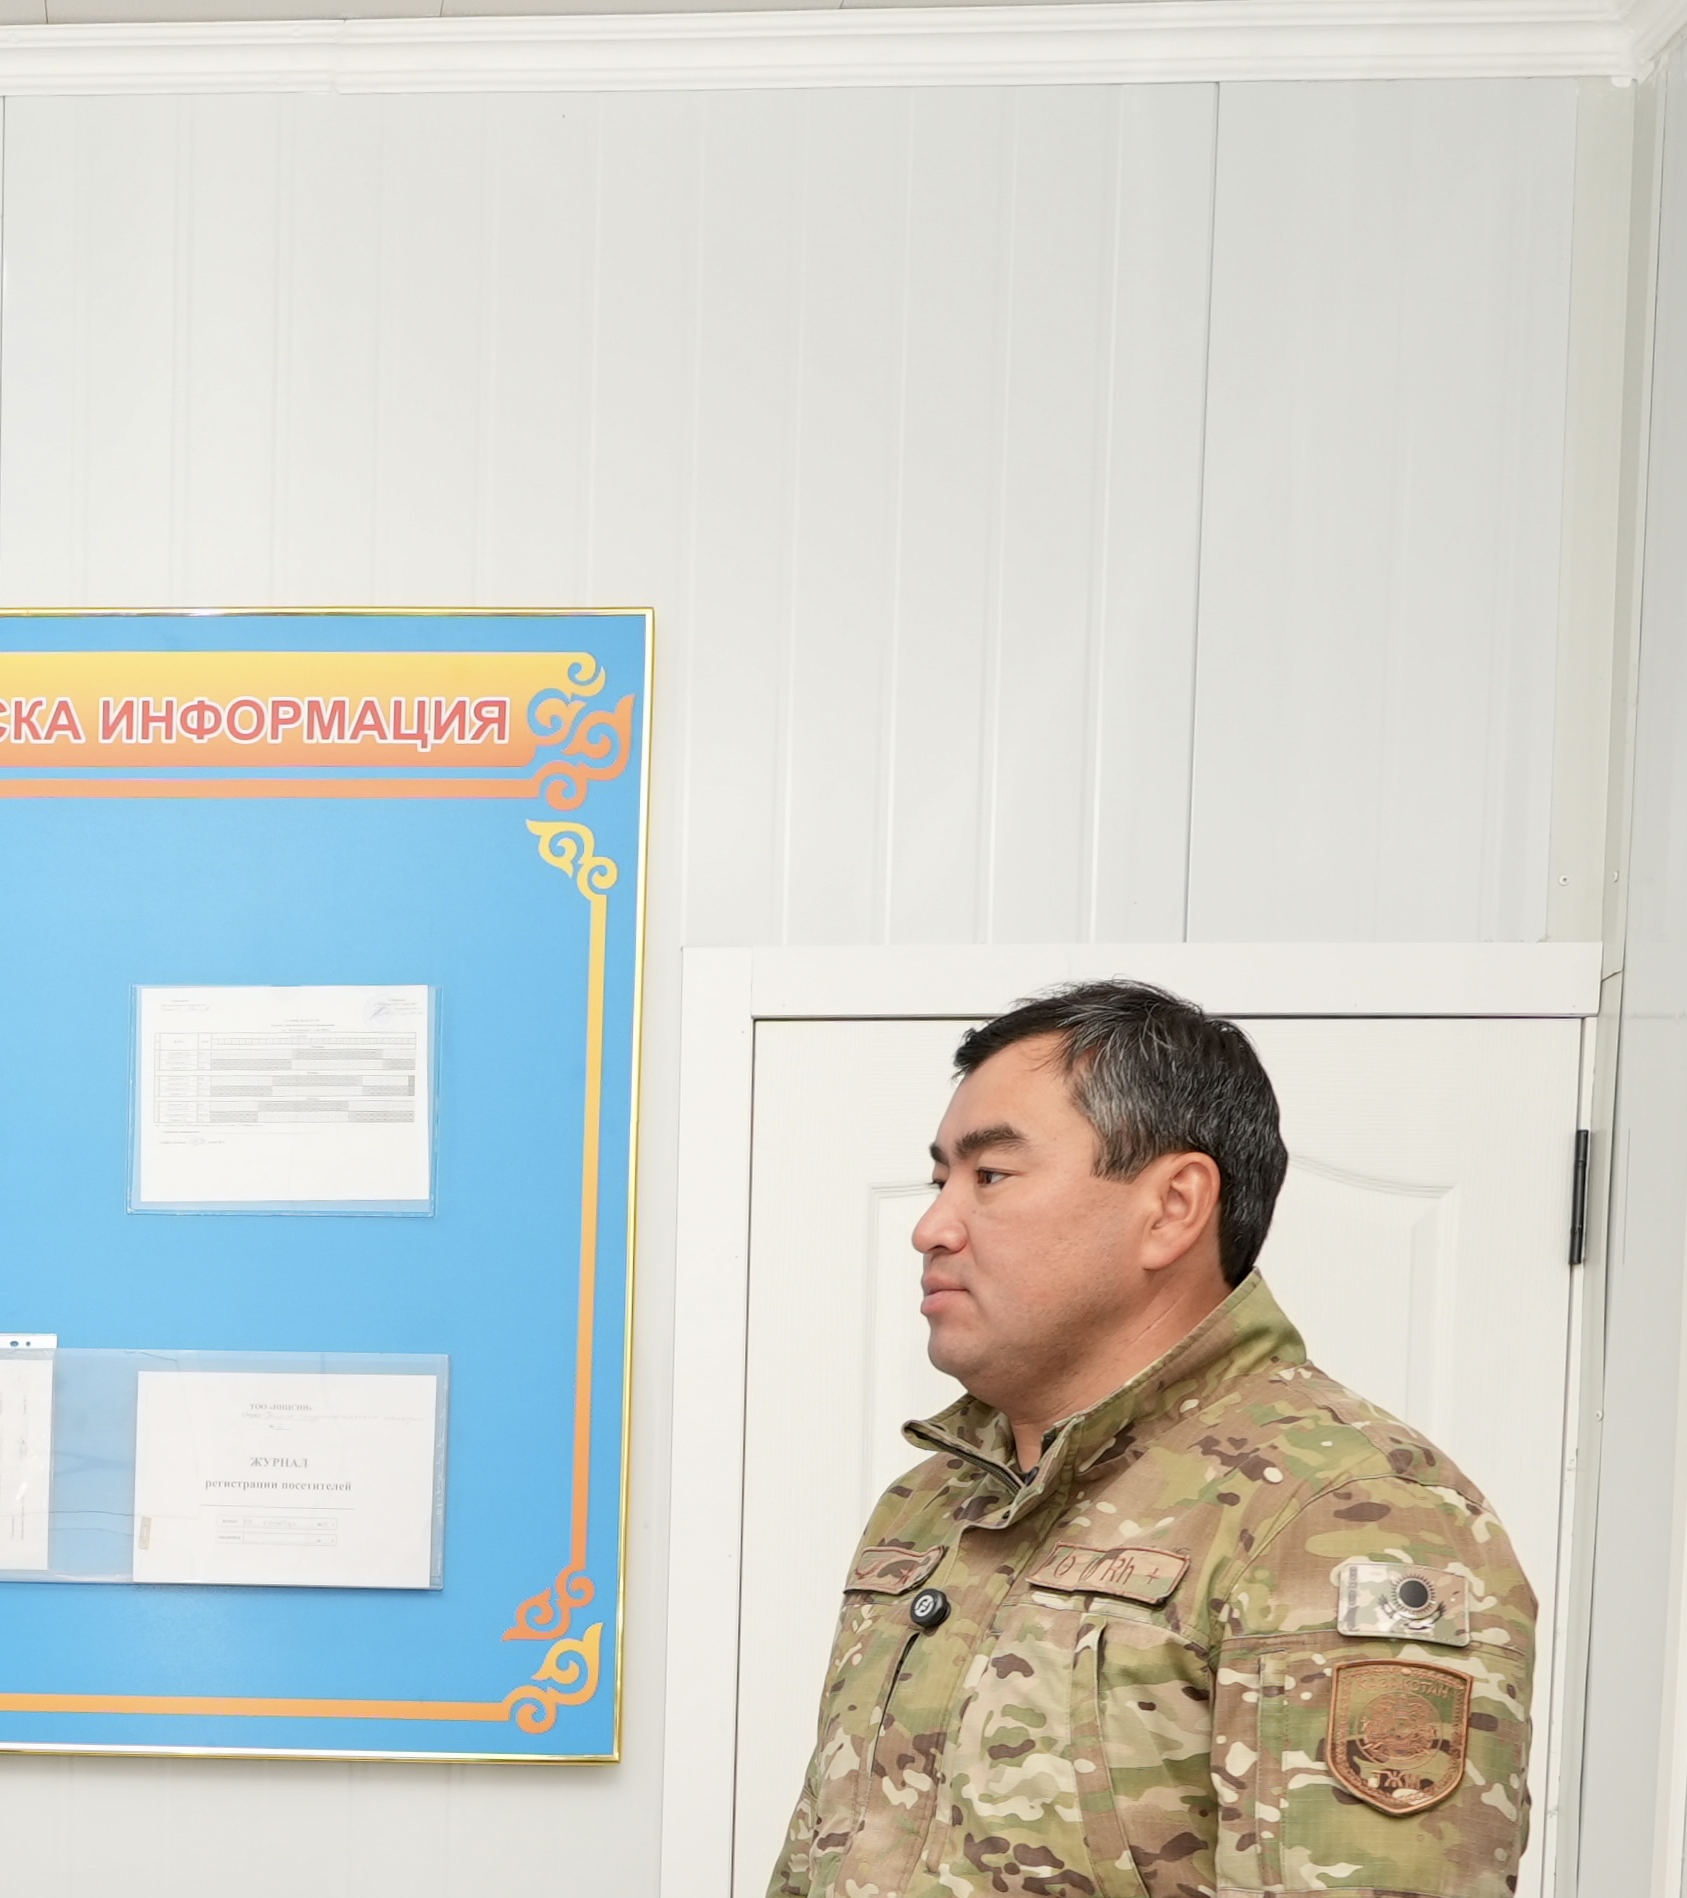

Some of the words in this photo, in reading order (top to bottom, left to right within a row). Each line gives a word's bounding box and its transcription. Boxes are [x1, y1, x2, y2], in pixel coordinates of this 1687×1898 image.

[99, 693, 511, 748] ИНФОРМАЦИЯ
[250, 1456, 308, 1469] ЖУРНАЛ
[205, 1478, 279, 1491] регистрации
[281, 1480, 352, 1492] посетителей
